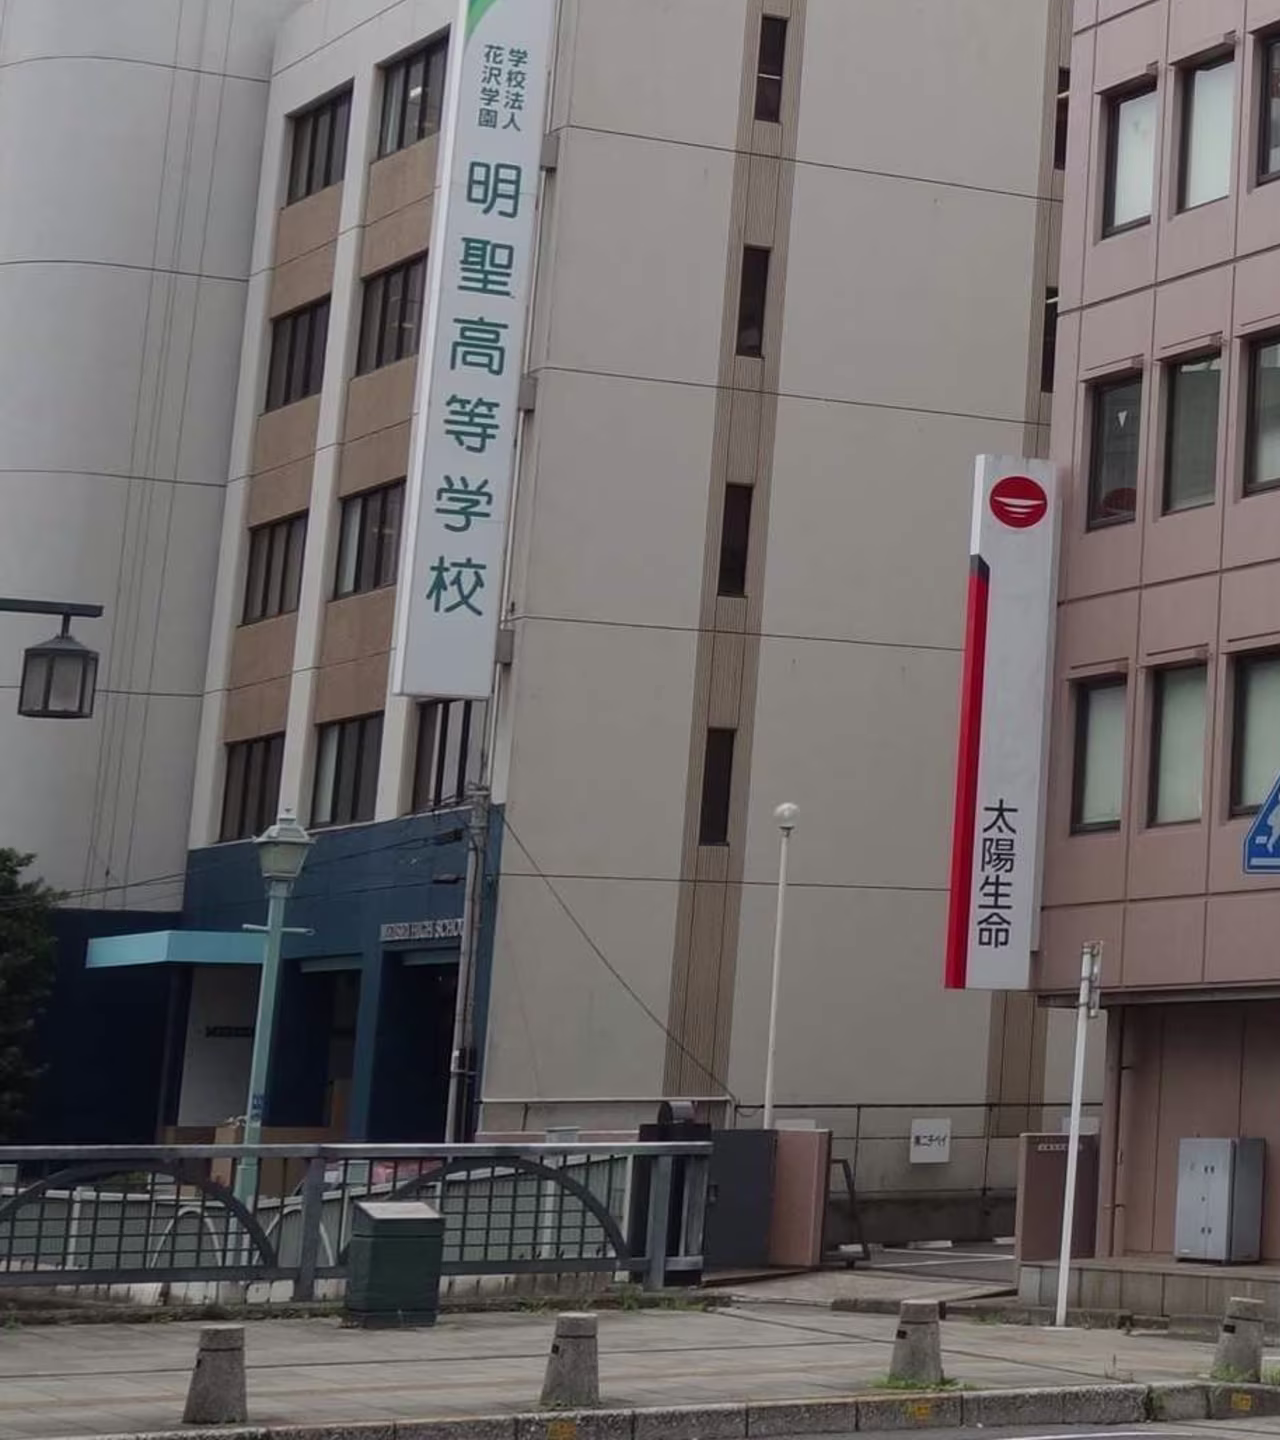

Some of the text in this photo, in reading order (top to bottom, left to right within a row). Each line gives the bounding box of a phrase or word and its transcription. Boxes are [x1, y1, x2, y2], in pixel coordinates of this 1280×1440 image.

[478, 45, 503, 129] 花沢学園
[502, 47, 528, 132] 学校法人
[425, 160, 523, 616] 明聖高等学校
[977, 798, 1018, 948] 太陽生命
